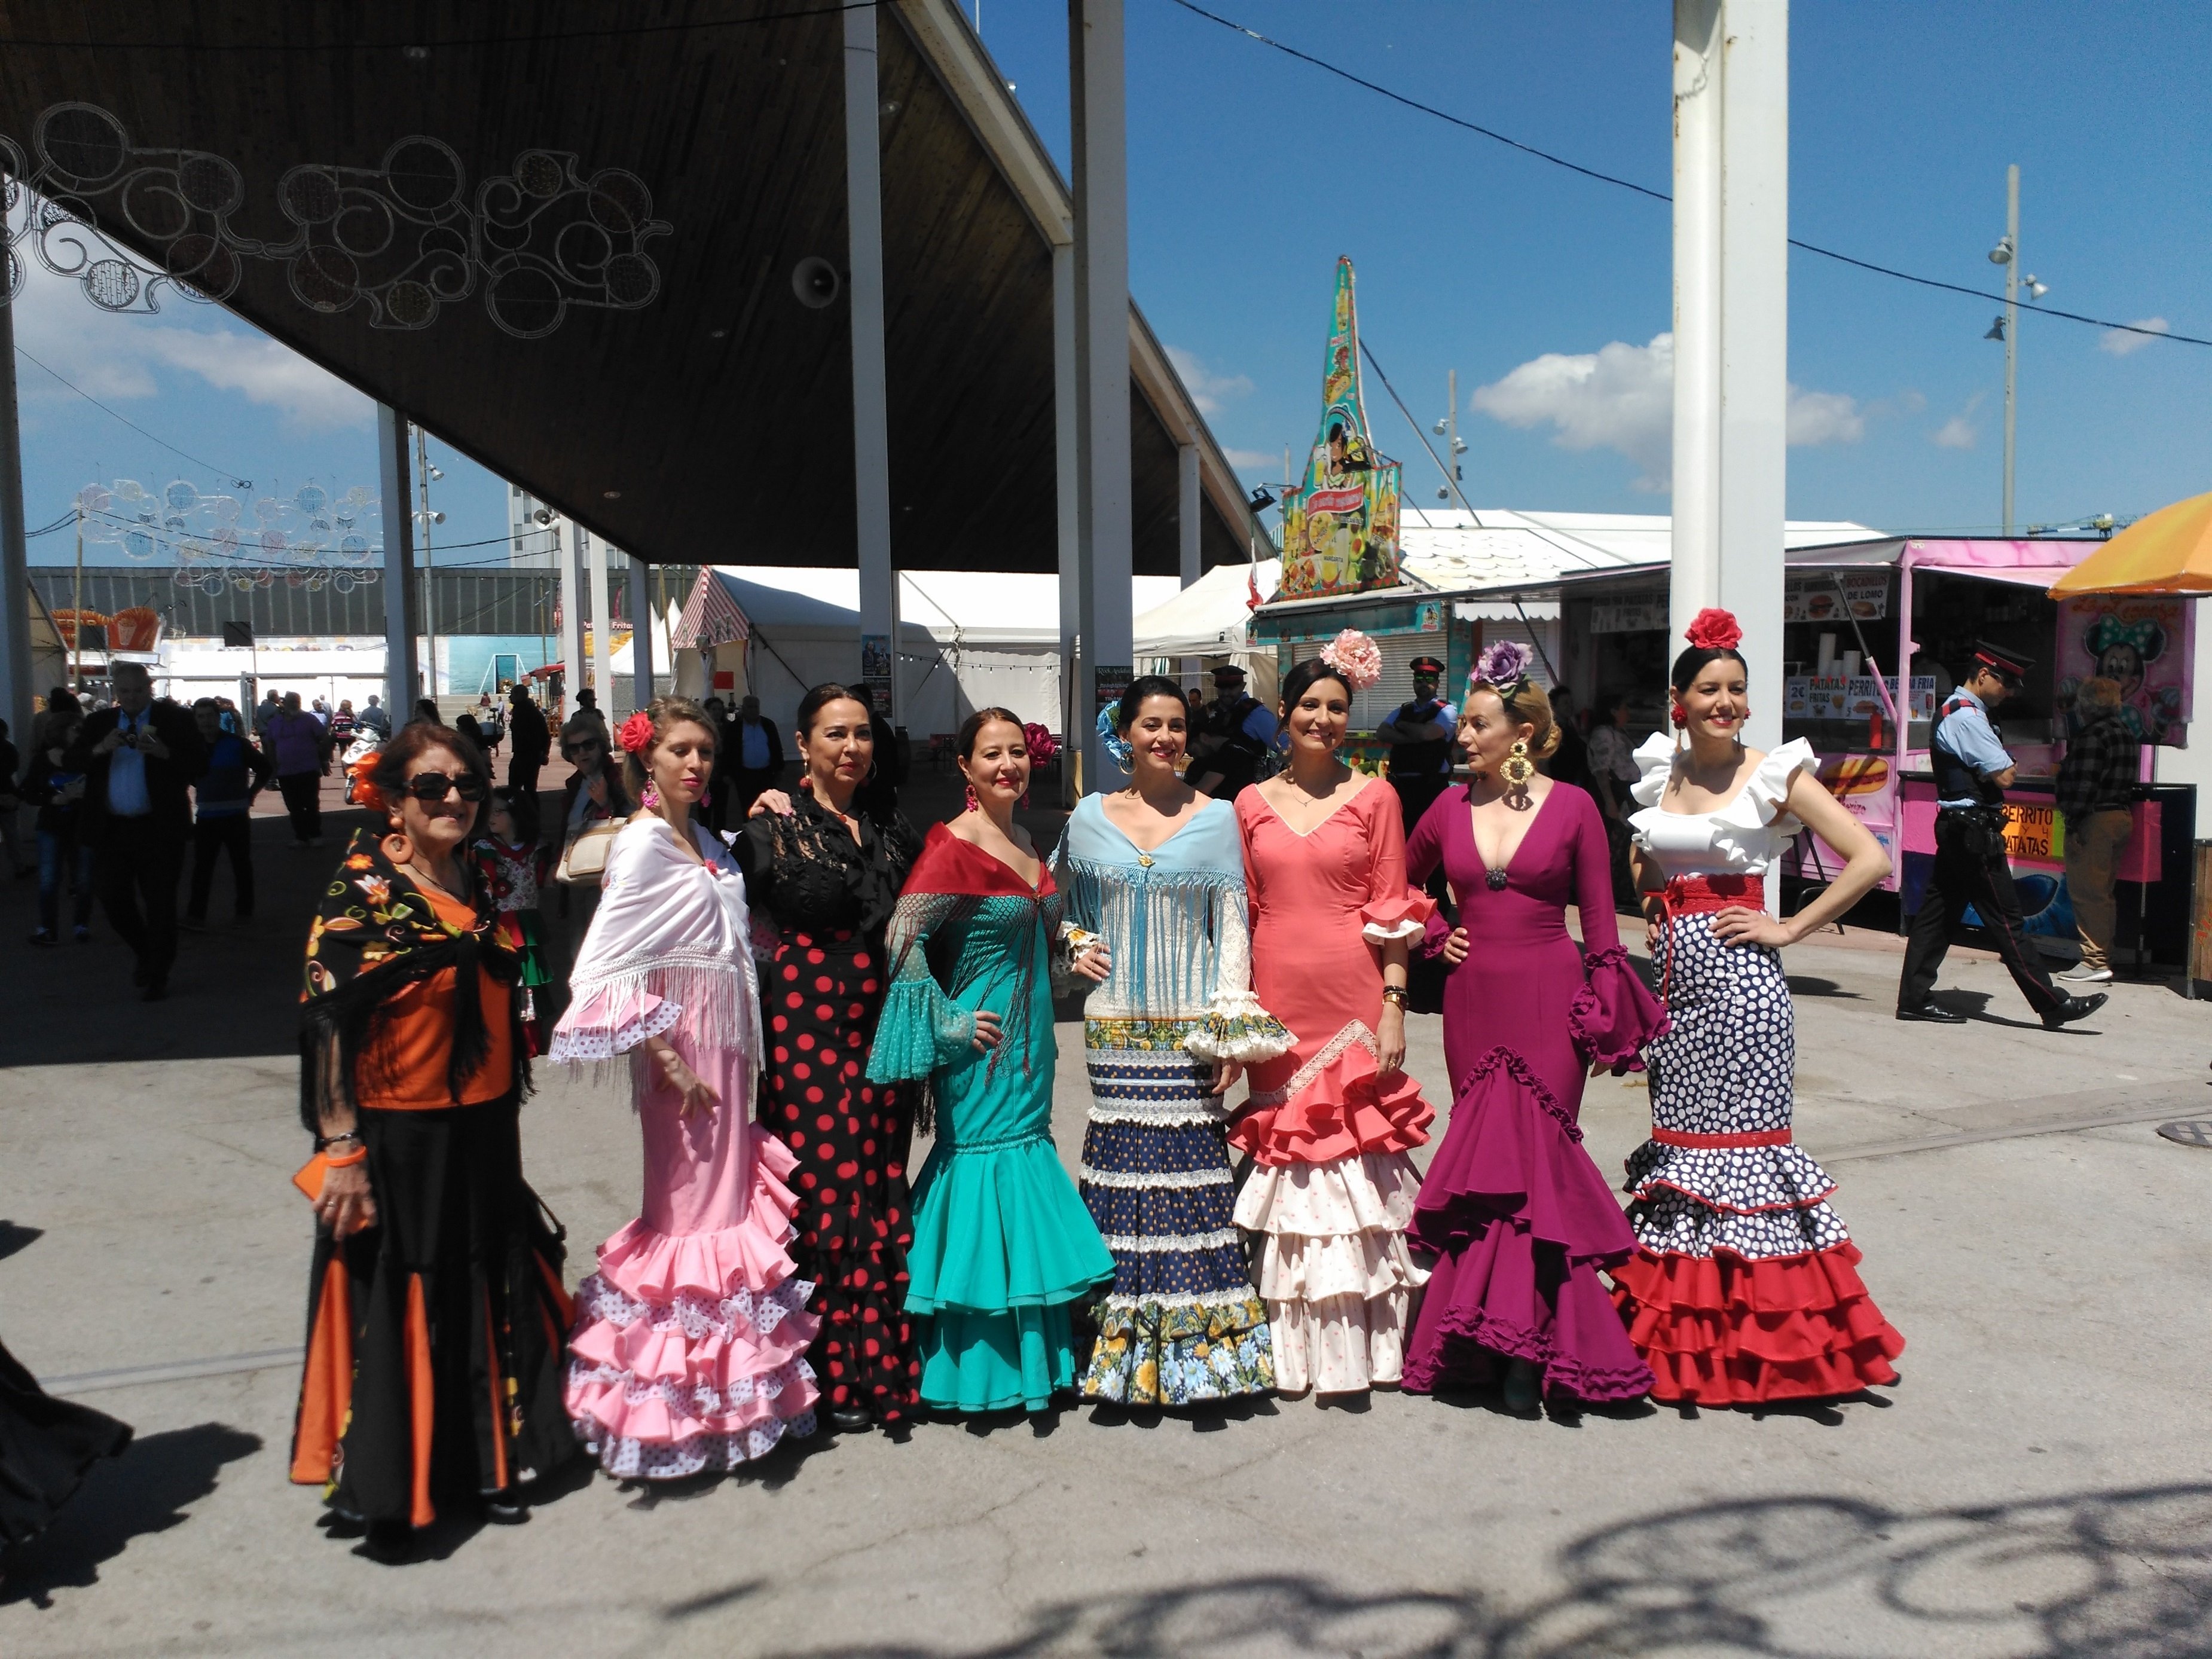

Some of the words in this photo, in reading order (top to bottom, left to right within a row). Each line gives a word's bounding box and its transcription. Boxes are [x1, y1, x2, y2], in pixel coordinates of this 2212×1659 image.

[1848, 591, 1857, 600] DE
[1860, 589, 1883, 599] LOMO
[1810, 678, 1846, 691] PATATAS
[1917, 677, 1934, 689] FRIA
[1791, 686, 1805, 698] 2€
[1809, 692, 1830, 703] FRITAS
[2005, 835, 2049, 856] ATATAS
